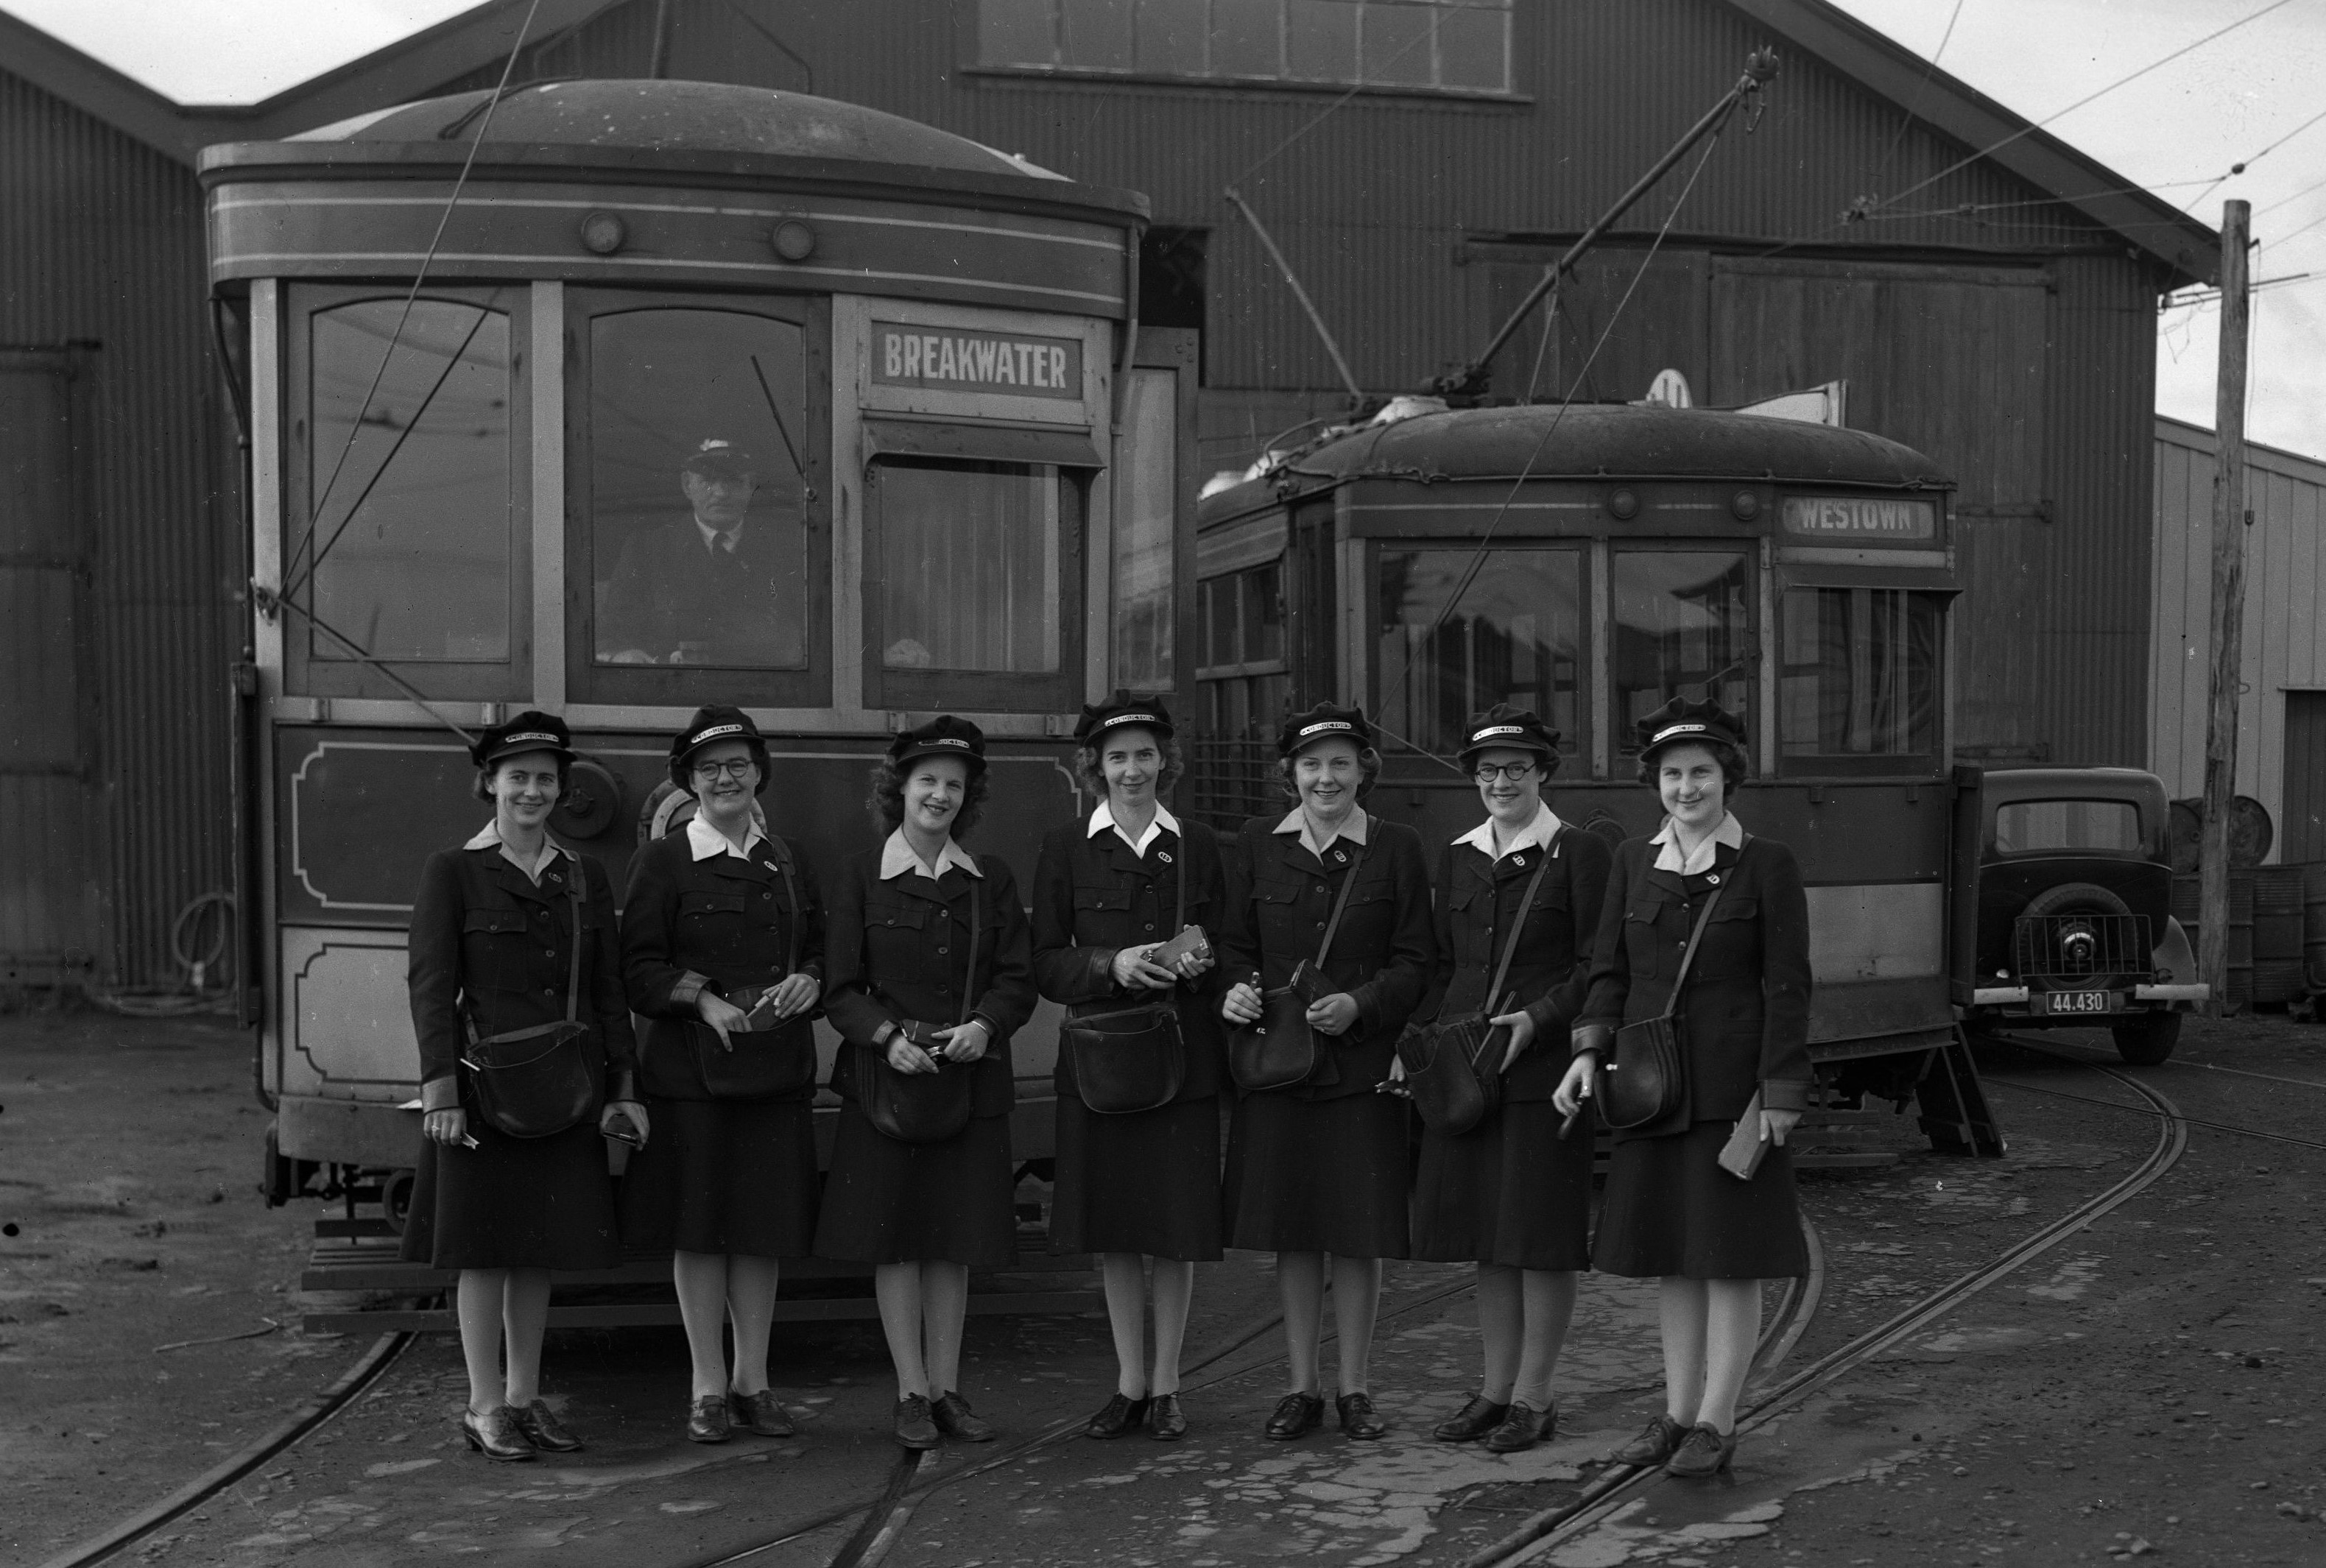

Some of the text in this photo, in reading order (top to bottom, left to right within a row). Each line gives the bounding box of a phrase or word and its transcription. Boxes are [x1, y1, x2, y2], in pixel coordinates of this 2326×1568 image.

[885, 333, 1066, 389] BREAKWATER
[1801, 498, 1911, 530] WESTOWN
[1105, 715, 1155, 726] CONDUCTOR
[1301, 722, 1350, 735] CONDUCTOR
[507, 733, 558, 742] CONDUCTOR
[692, 724, 742, 742] CONDUCTOR
[2053, 993, 2103, 1011] 44.430
